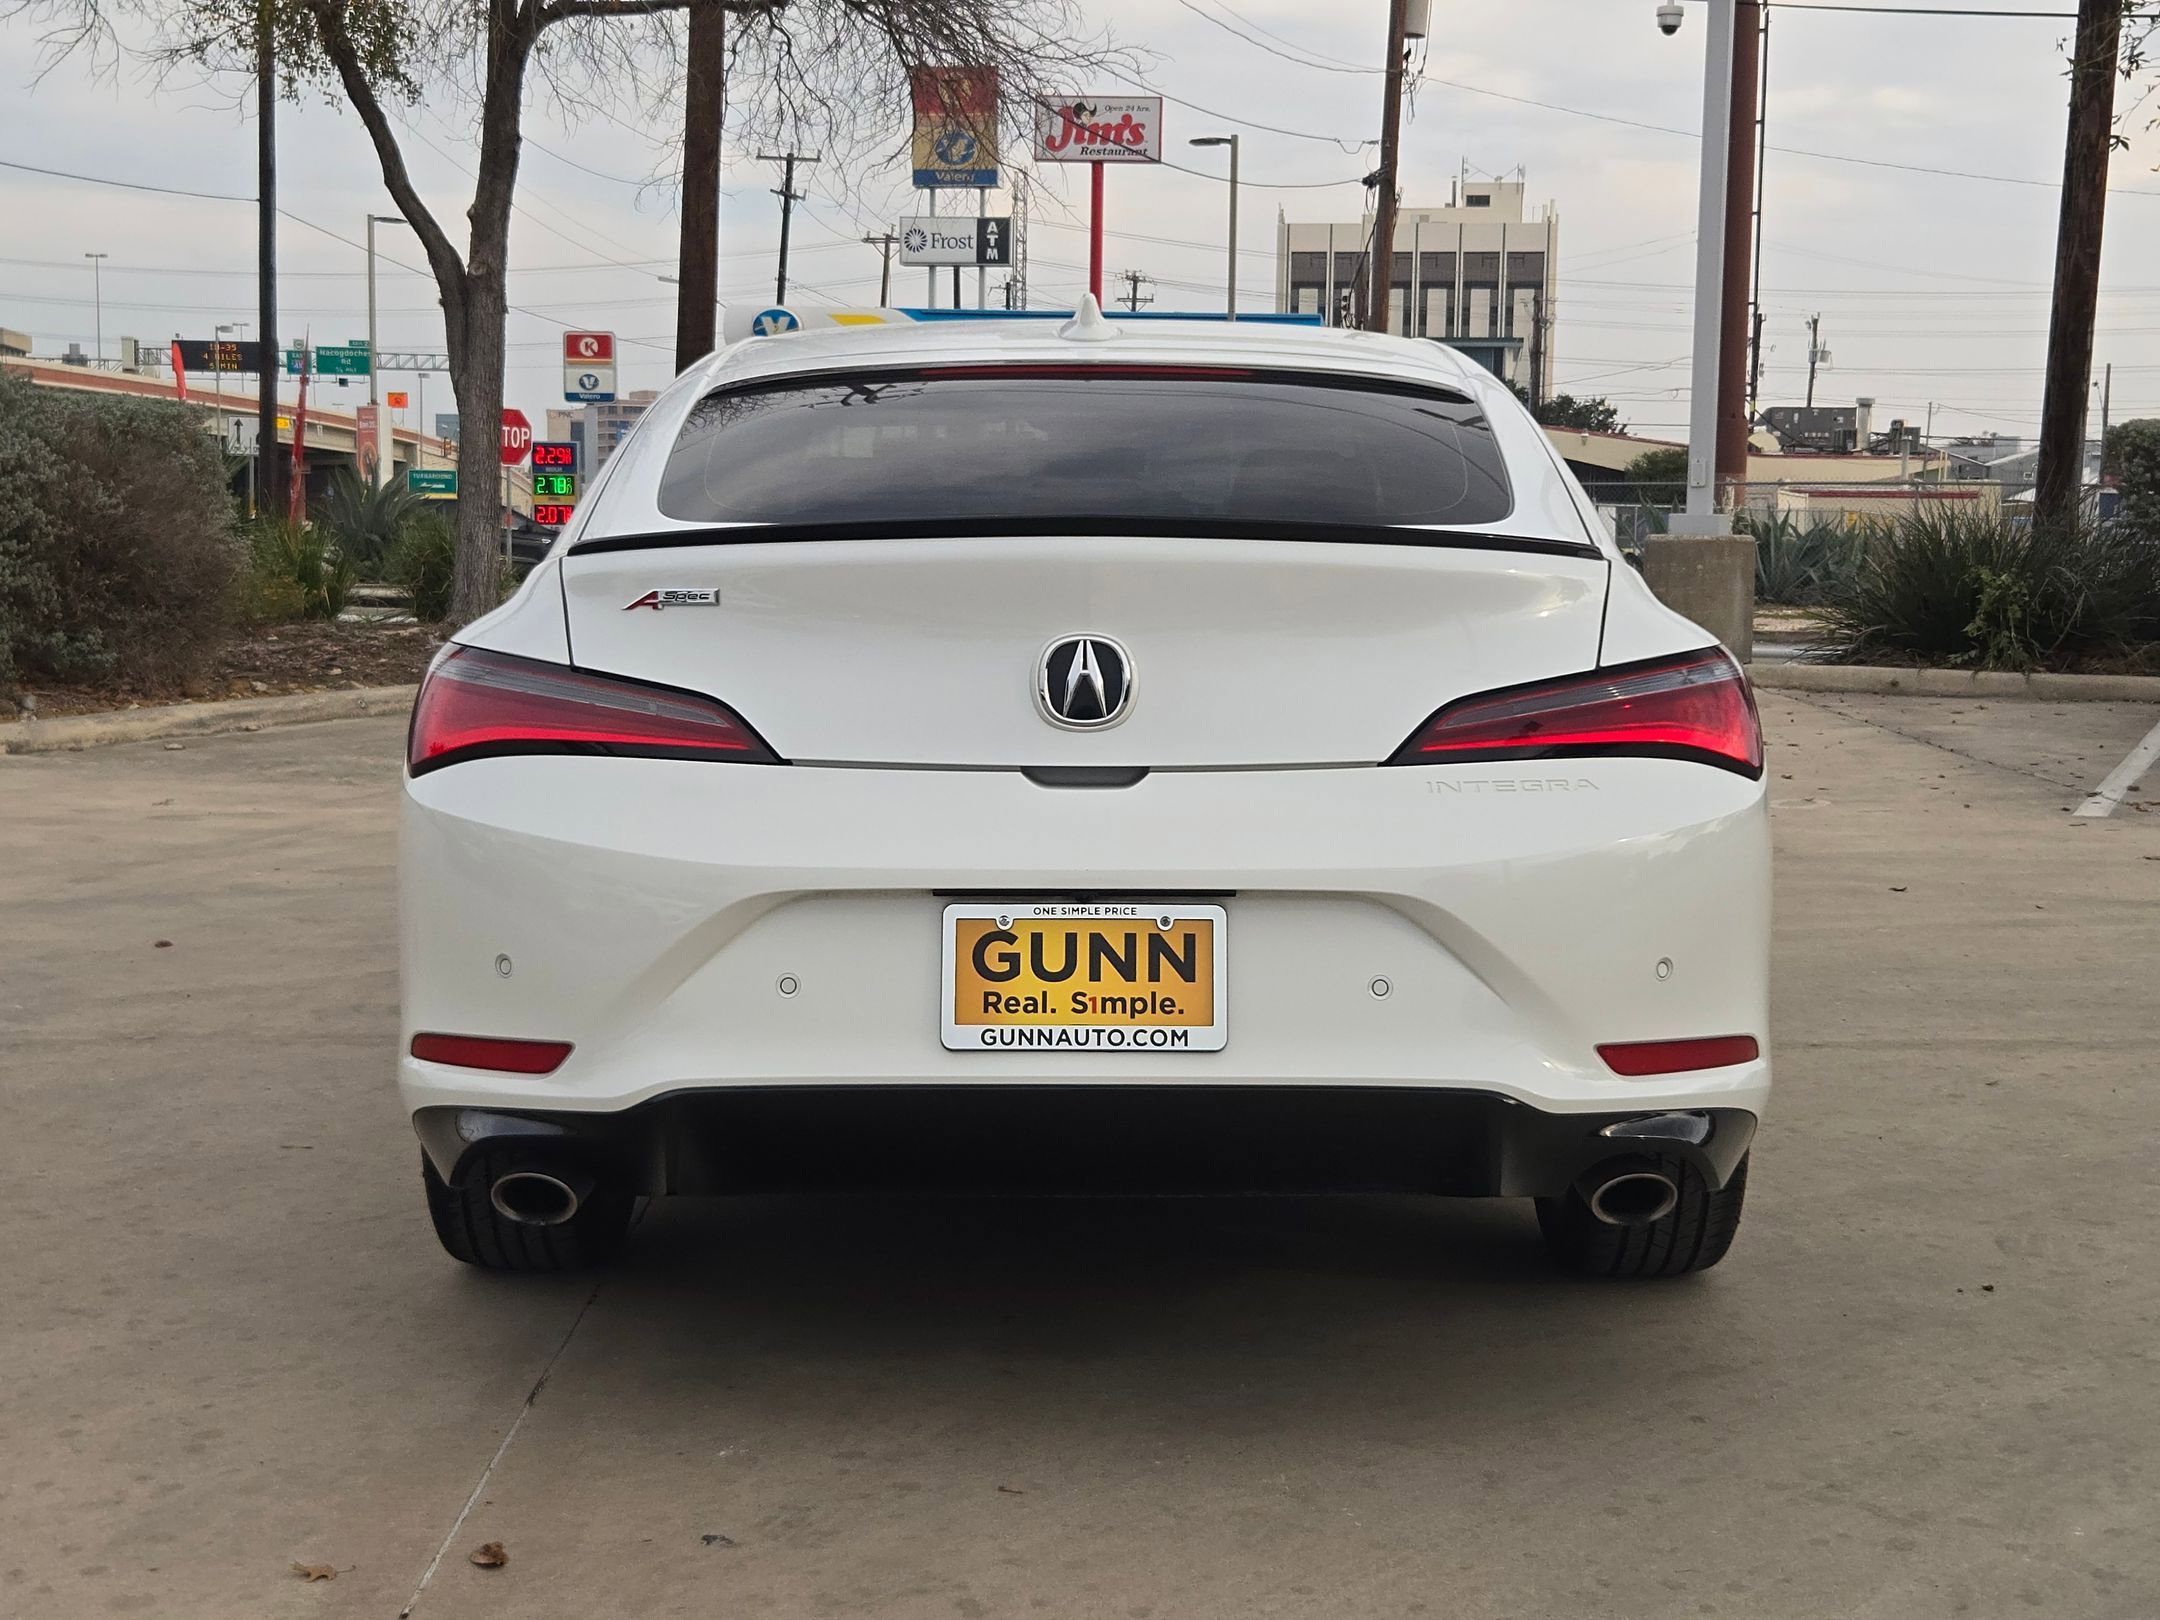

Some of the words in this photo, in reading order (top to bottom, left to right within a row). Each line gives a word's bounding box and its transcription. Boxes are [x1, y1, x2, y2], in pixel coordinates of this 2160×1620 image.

[1104, 105, 1123, 113] Open
[1045, 106, 1146, 152] Jim's
[1080, 146, 1148, 156] Restaurant
[931, 233, 974, 249] Frost
[986, 221, 999, 260] ATM
[502, 426, 530, 449] TOP
[536, 477, 567, 493] 2.78
[1426, 778, 1600, 793] INTEGRA
[1033, 906, 1057, 916] ONE
[1061, 906, 1101, 916] SIMPLE
[1104, 906, 1138, 916] PRICE
[972, 930, 1196, 983] GUNN
[983, 991, 1057, 1014] Real.
[980, 1028, 1189, 1047] GUNNAUTO.COM
